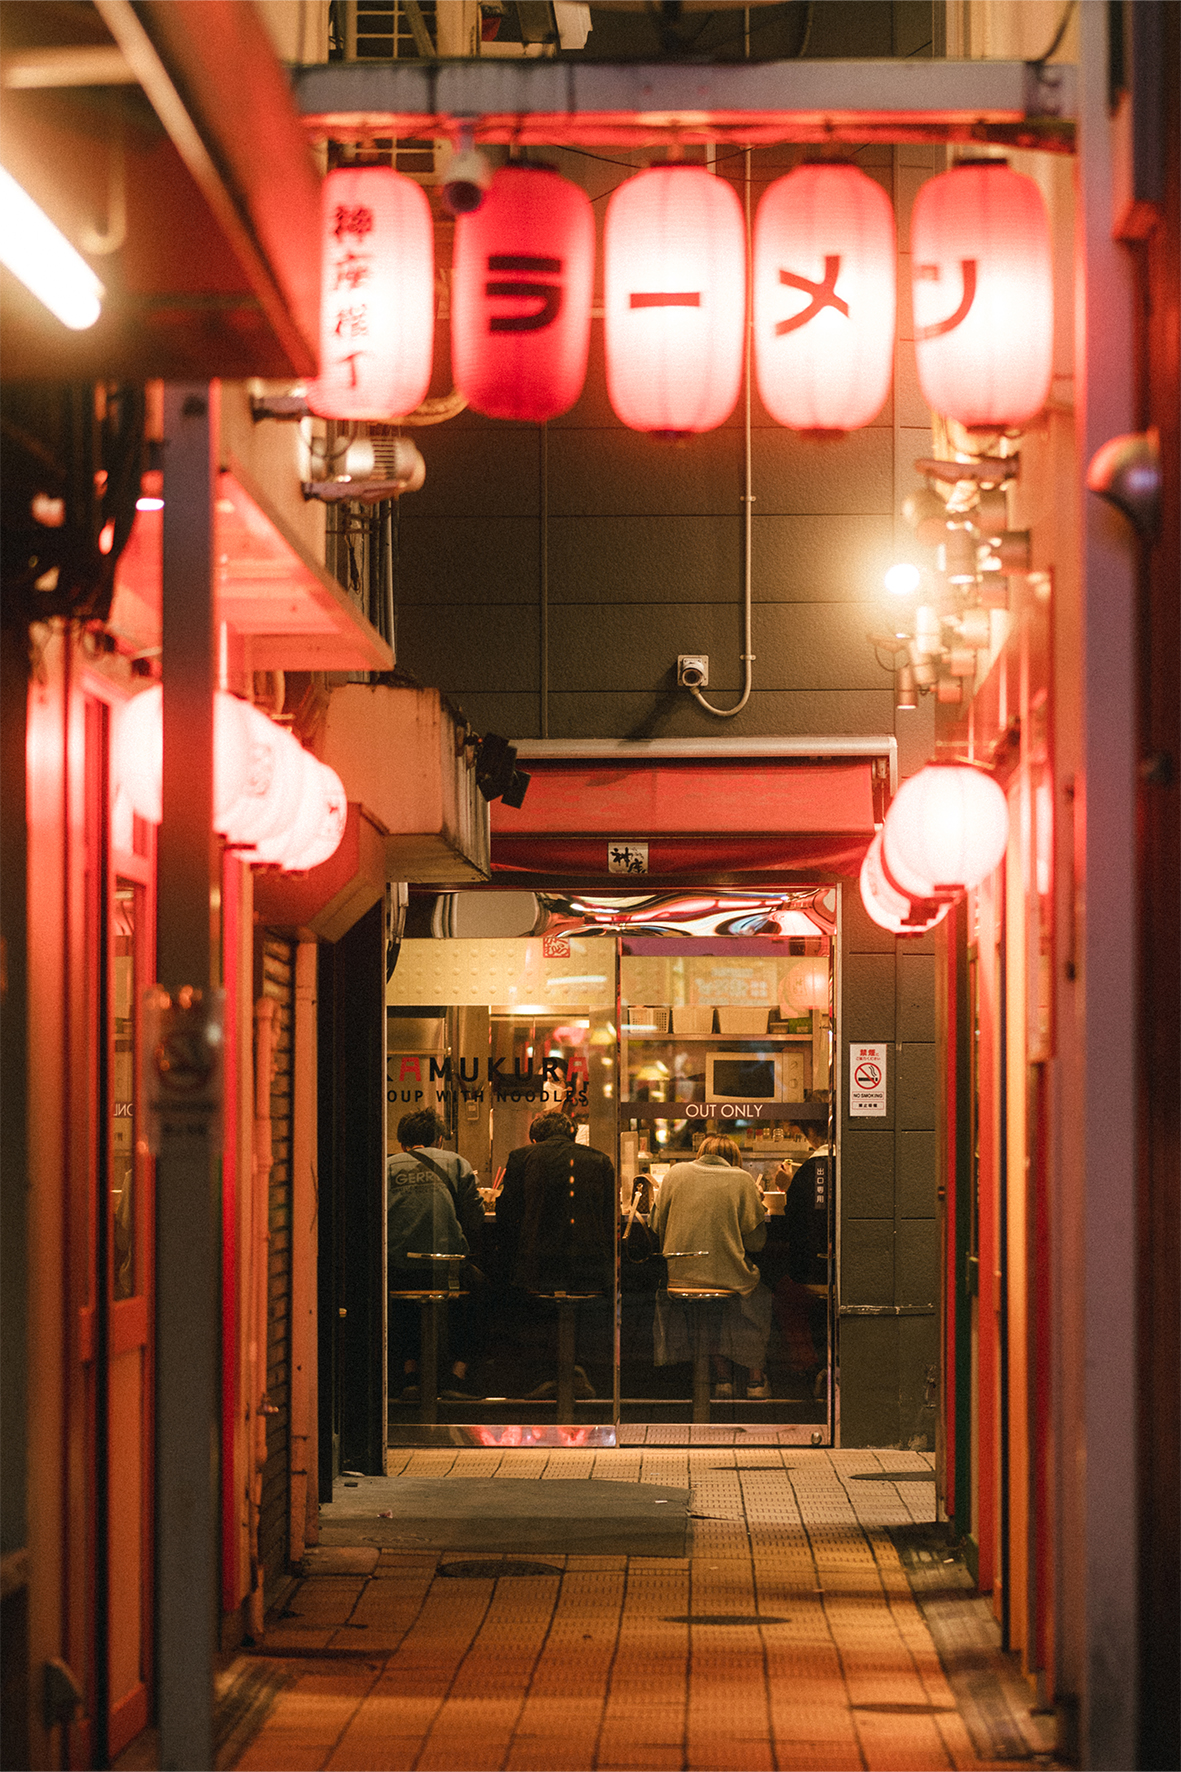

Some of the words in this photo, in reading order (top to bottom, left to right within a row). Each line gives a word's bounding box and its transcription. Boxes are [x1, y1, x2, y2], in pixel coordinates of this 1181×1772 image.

[387, 1090, 423, 1102] OUP
[436, 1090, 484, 1102] WITH
[497, 1089, 588, 1103] NOODLES
[685, 1103, 717, 1118] OUT
[720, 1103, 763, 1118] ONLY
[395, 1171, 434, 1185] GERR
